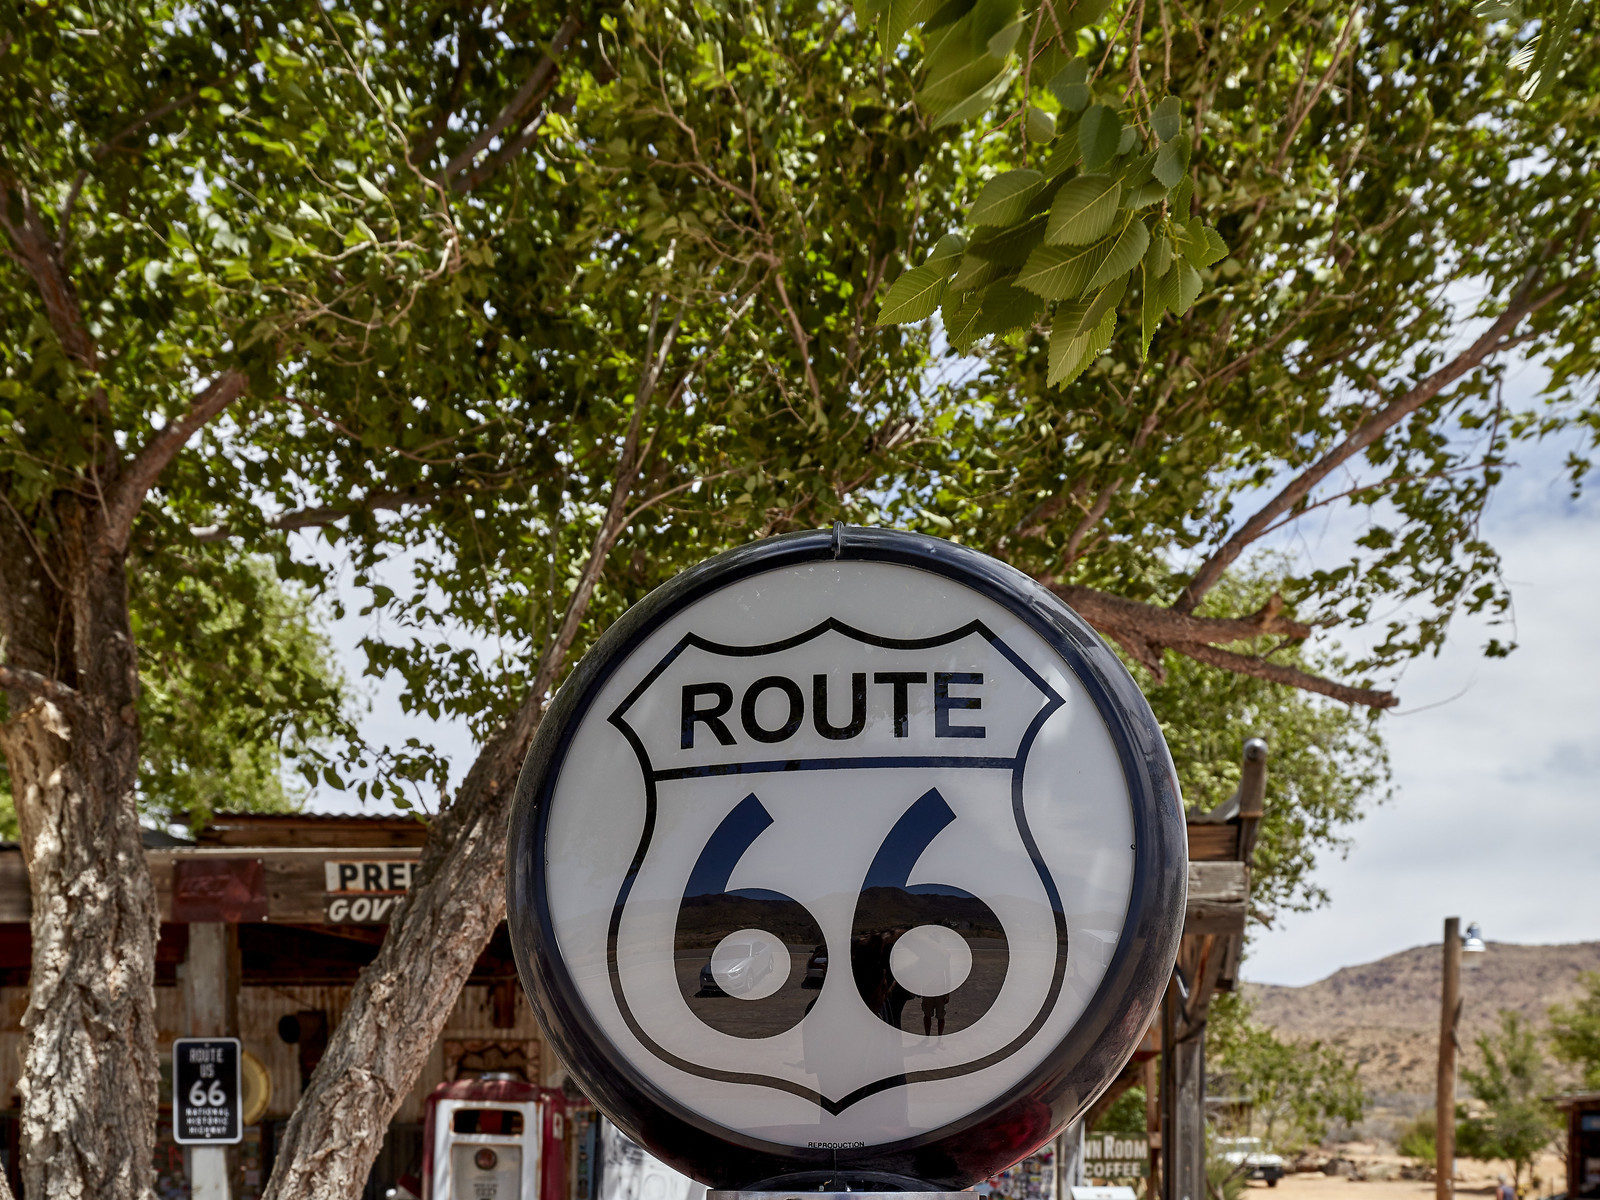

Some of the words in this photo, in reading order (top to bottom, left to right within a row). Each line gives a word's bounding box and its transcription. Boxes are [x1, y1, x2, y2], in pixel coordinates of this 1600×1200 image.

[681, 672, 985, 749] ROUTE
[674, 787, 1009, 1039] 66
[189, 1048, 224, 1062] ROUTE
[200, 1063, 215, 1078] US
[189, 1080, 226, 1107] 66
[807, 1141, 865, 1149] REPRODUCTION
[1084, 1161, 1141, 1177] COFFEE
